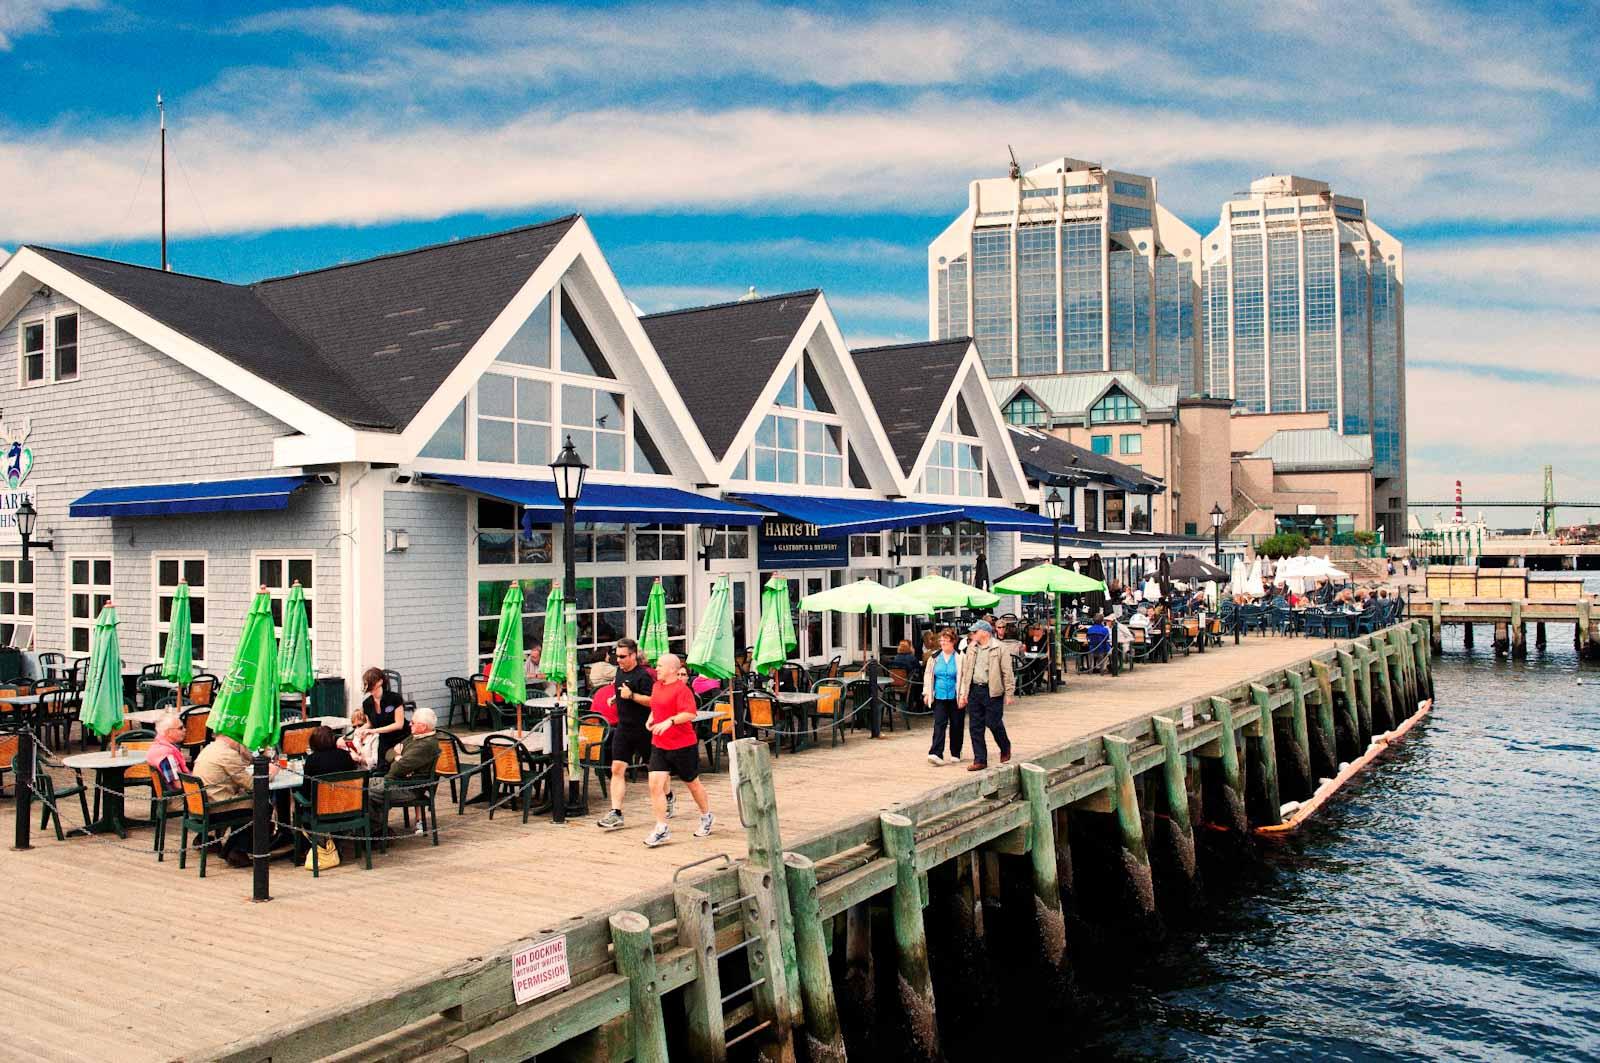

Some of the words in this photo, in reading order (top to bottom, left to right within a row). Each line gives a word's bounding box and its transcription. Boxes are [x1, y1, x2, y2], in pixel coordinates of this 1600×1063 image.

[0, 493, 27, 509] ART
[765, 522, 795, 537] HART
[804, 523, 819, 537] TH
[516, 954, 527, 968] NO
[529, 941, 563, 962] DOCKING
[516, 962, 540, 977] WITHOUT
[541, 954, 564, 968] WRITTEN
[517, 964, 565, 992] PERMISSION
